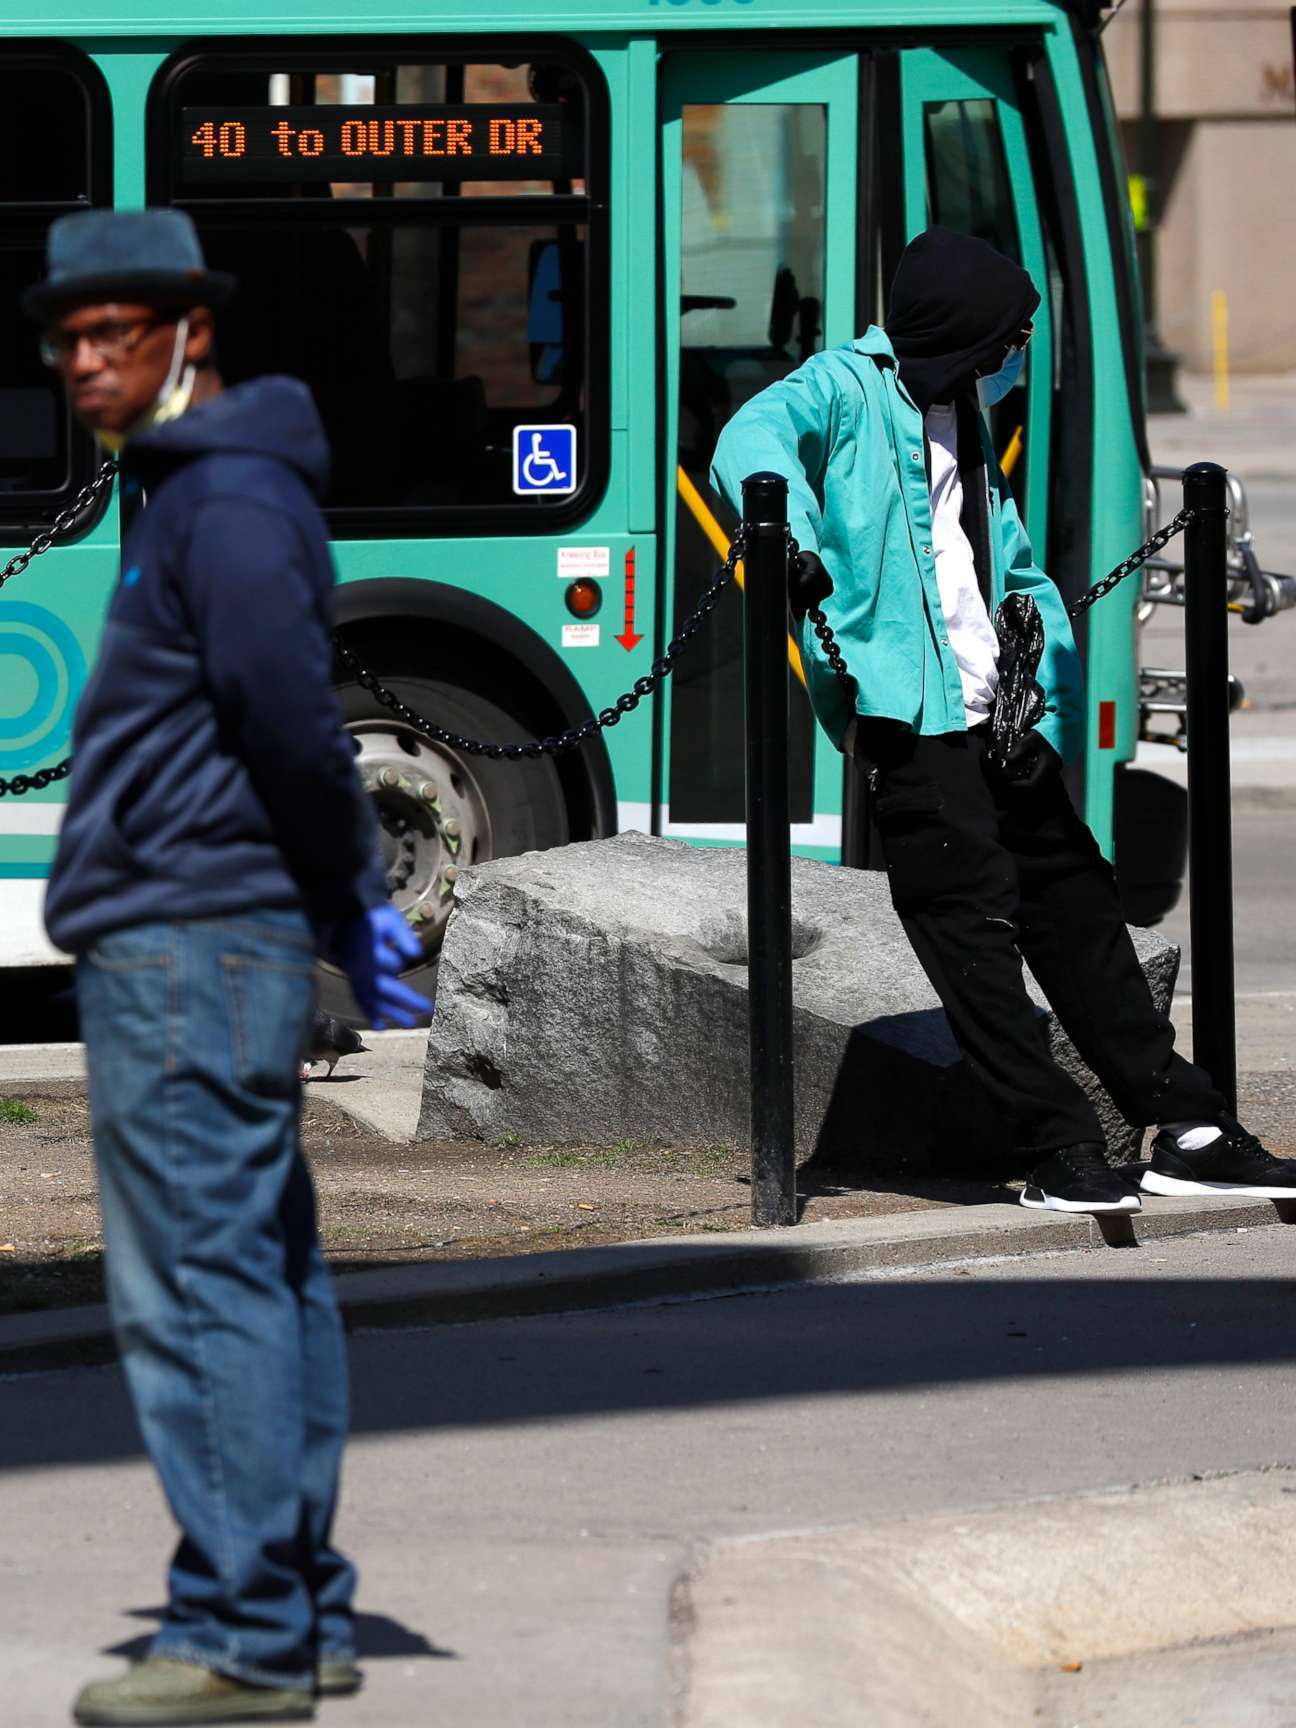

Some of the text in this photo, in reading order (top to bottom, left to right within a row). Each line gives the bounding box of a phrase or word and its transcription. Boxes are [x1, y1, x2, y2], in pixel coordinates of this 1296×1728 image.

[191, 118, 543, 157] 40 to OUTER DR
